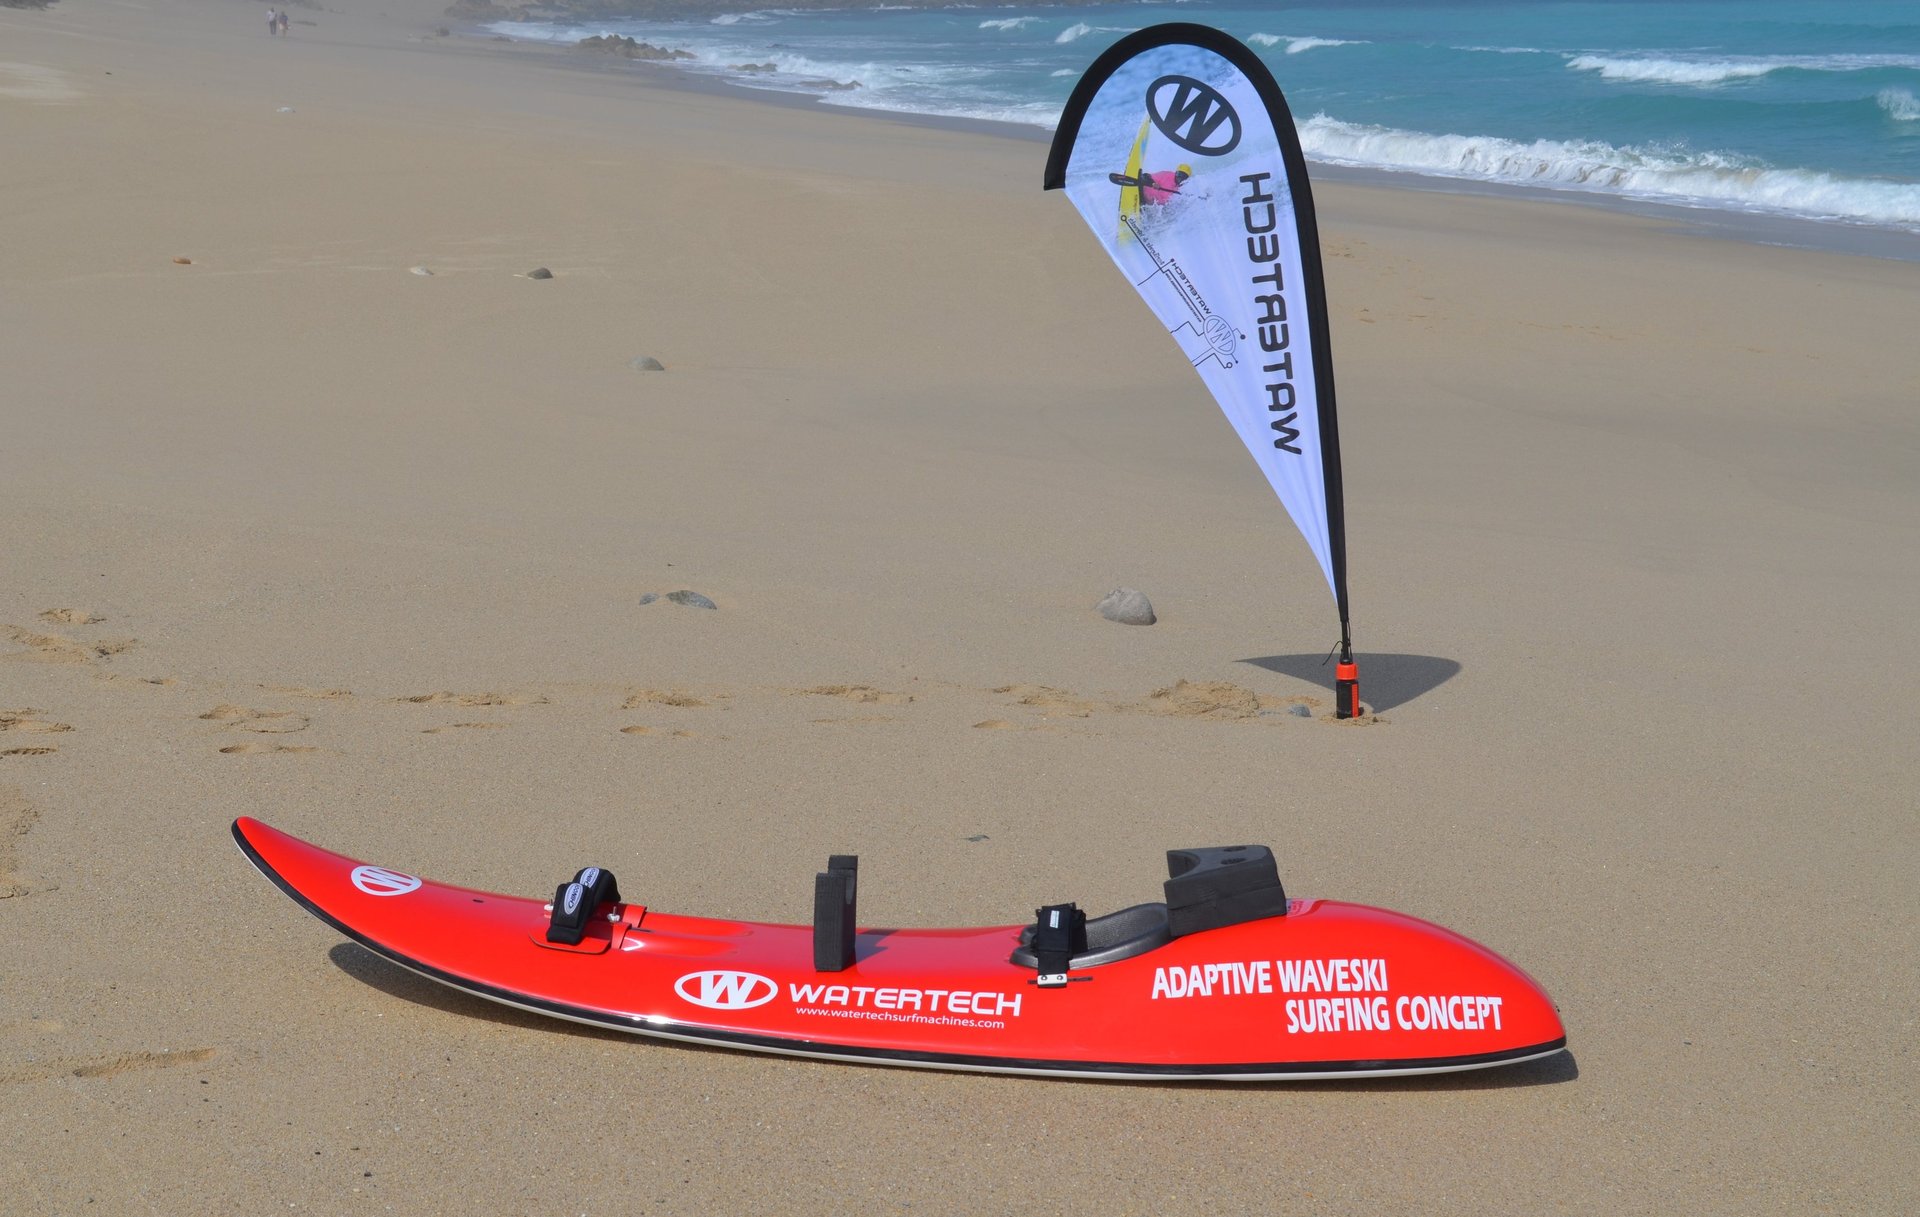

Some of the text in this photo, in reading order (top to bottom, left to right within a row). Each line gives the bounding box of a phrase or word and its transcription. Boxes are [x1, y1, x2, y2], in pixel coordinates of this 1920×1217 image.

[1151, 959, 1388, 1000] ADAPTIVE WAVESKI
[789, 983, 1022, 1017] WATERTECH
[796, 1007, 1005, 1029] www.watertechsurfmachines.com
[1285, 996, 1502, 1034] SURFING CONCEPT
